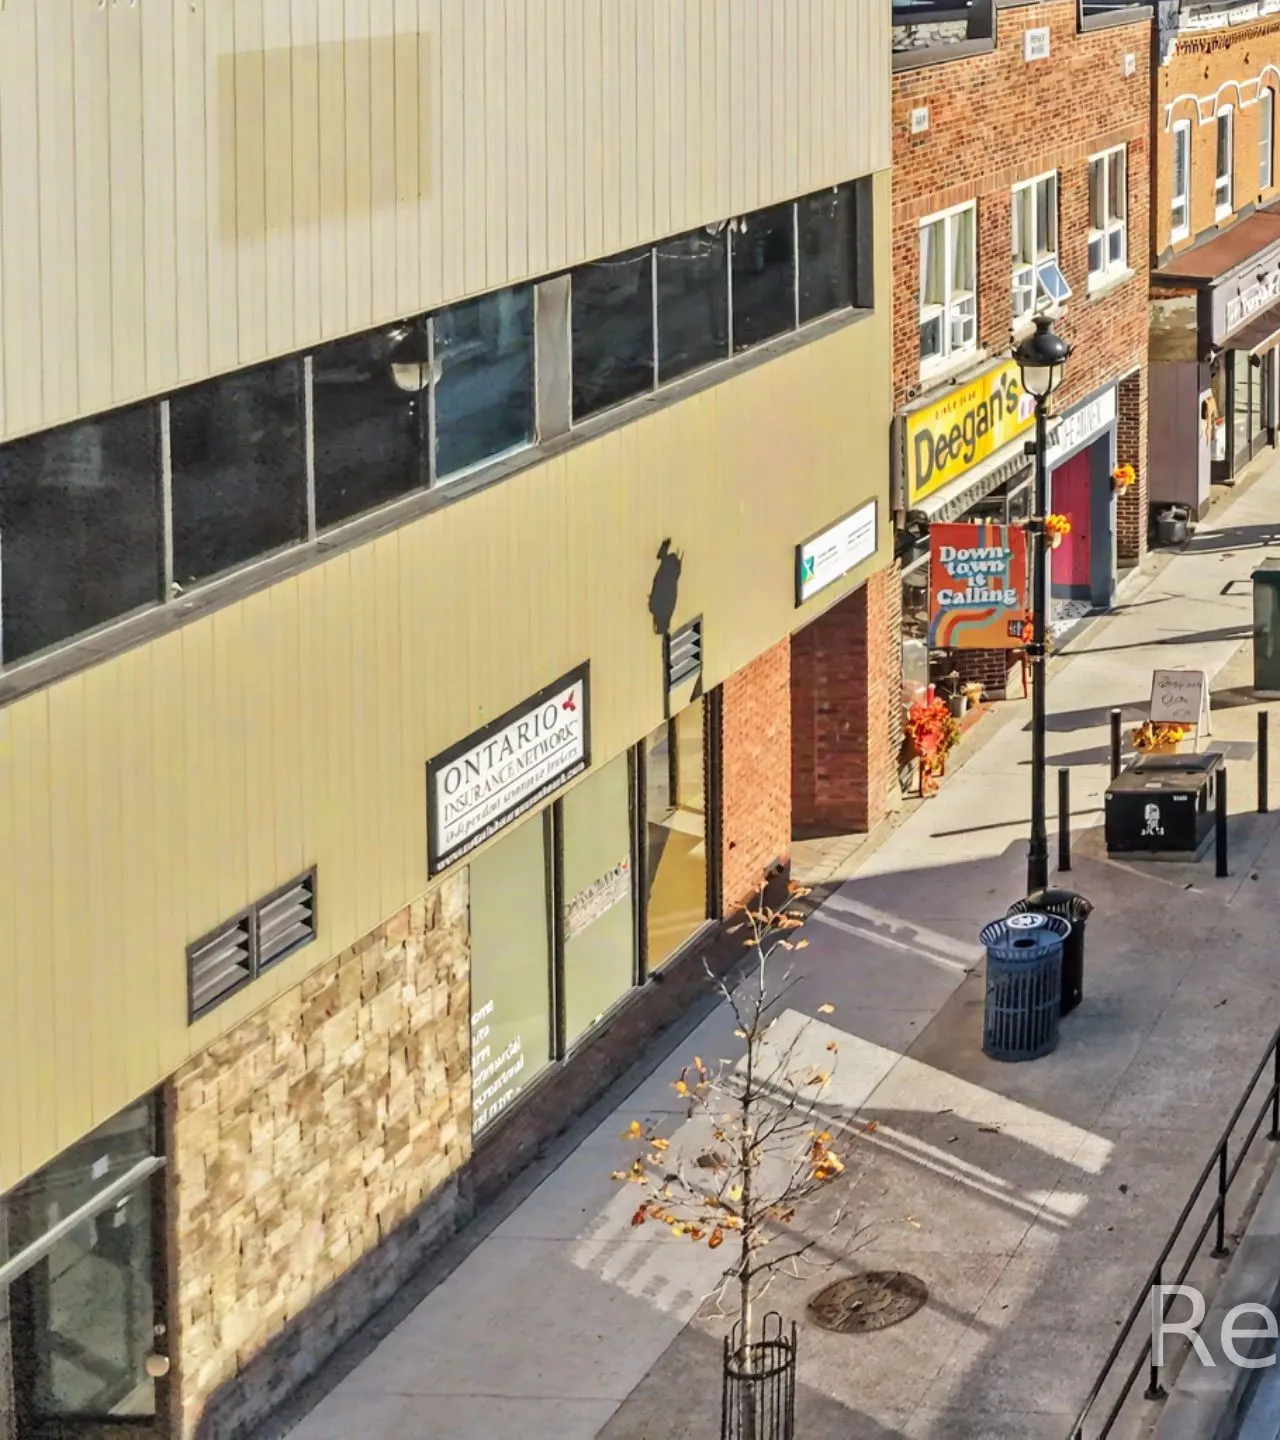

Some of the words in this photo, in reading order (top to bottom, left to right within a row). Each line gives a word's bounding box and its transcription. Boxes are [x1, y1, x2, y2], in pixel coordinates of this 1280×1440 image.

[914, 372, 1018, 491] Deegan's
[937, 587, 1017, 605] Calling
[946, 560, 1005, 576] town
[444, 704, 558, 795] ONTARIO
[444, 761, 515, 822] INSURANCE
